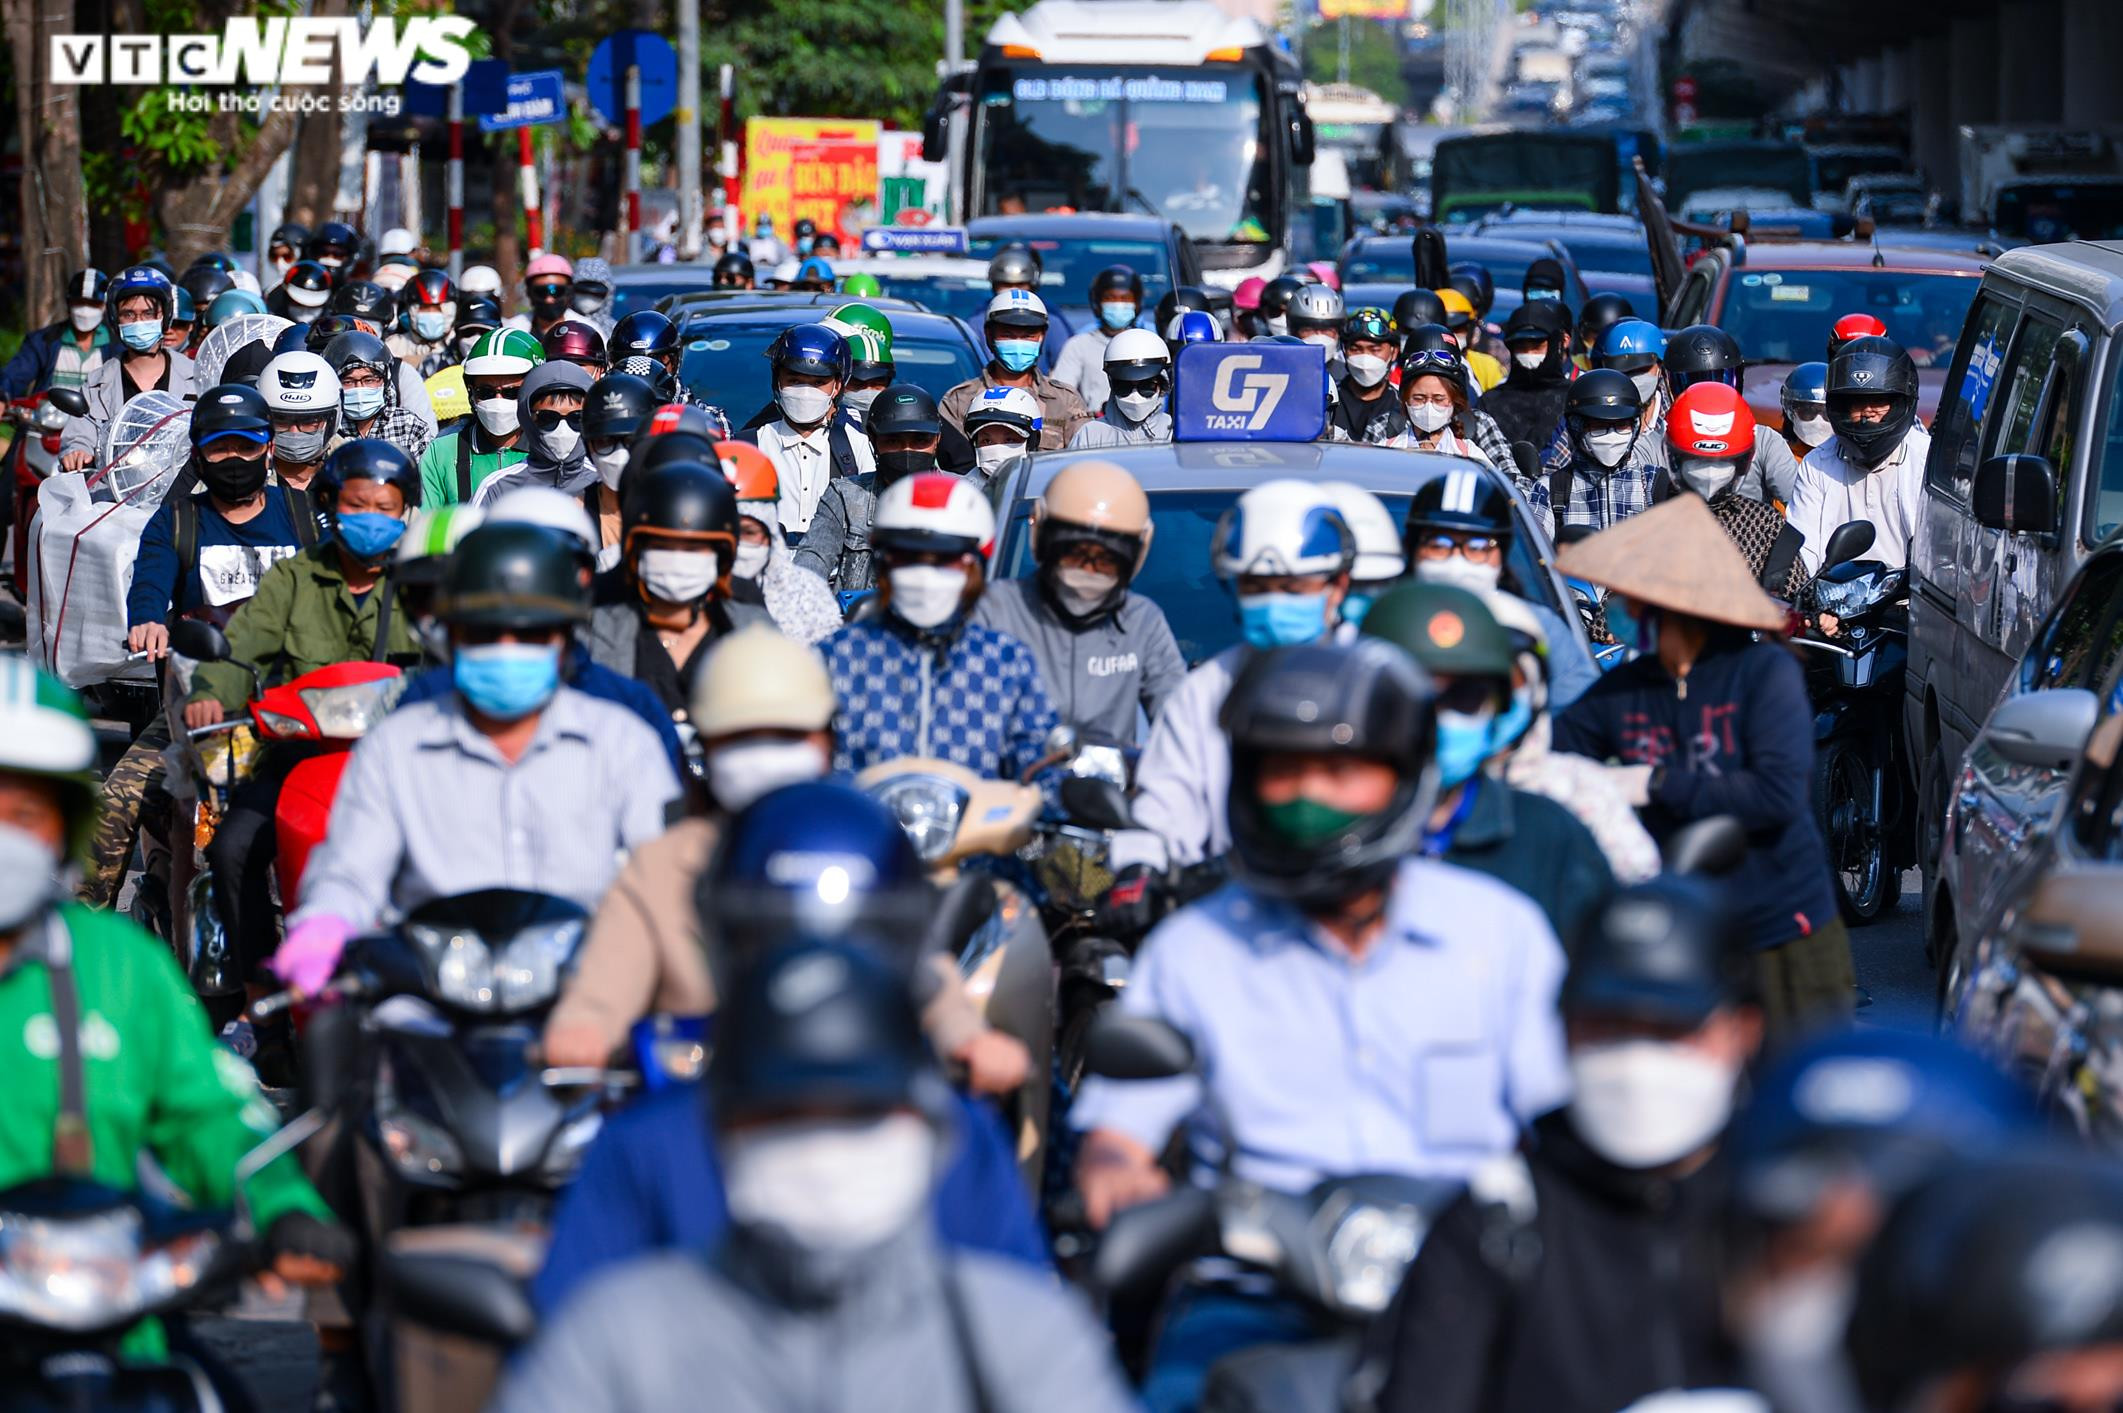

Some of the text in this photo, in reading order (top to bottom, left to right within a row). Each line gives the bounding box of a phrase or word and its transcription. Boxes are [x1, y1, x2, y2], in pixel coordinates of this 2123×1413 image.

[1212, 354, 1290, 430] G7
[1206, 415, 1246, 430] TAXI
[220, 572, 260, 586] GREAT
